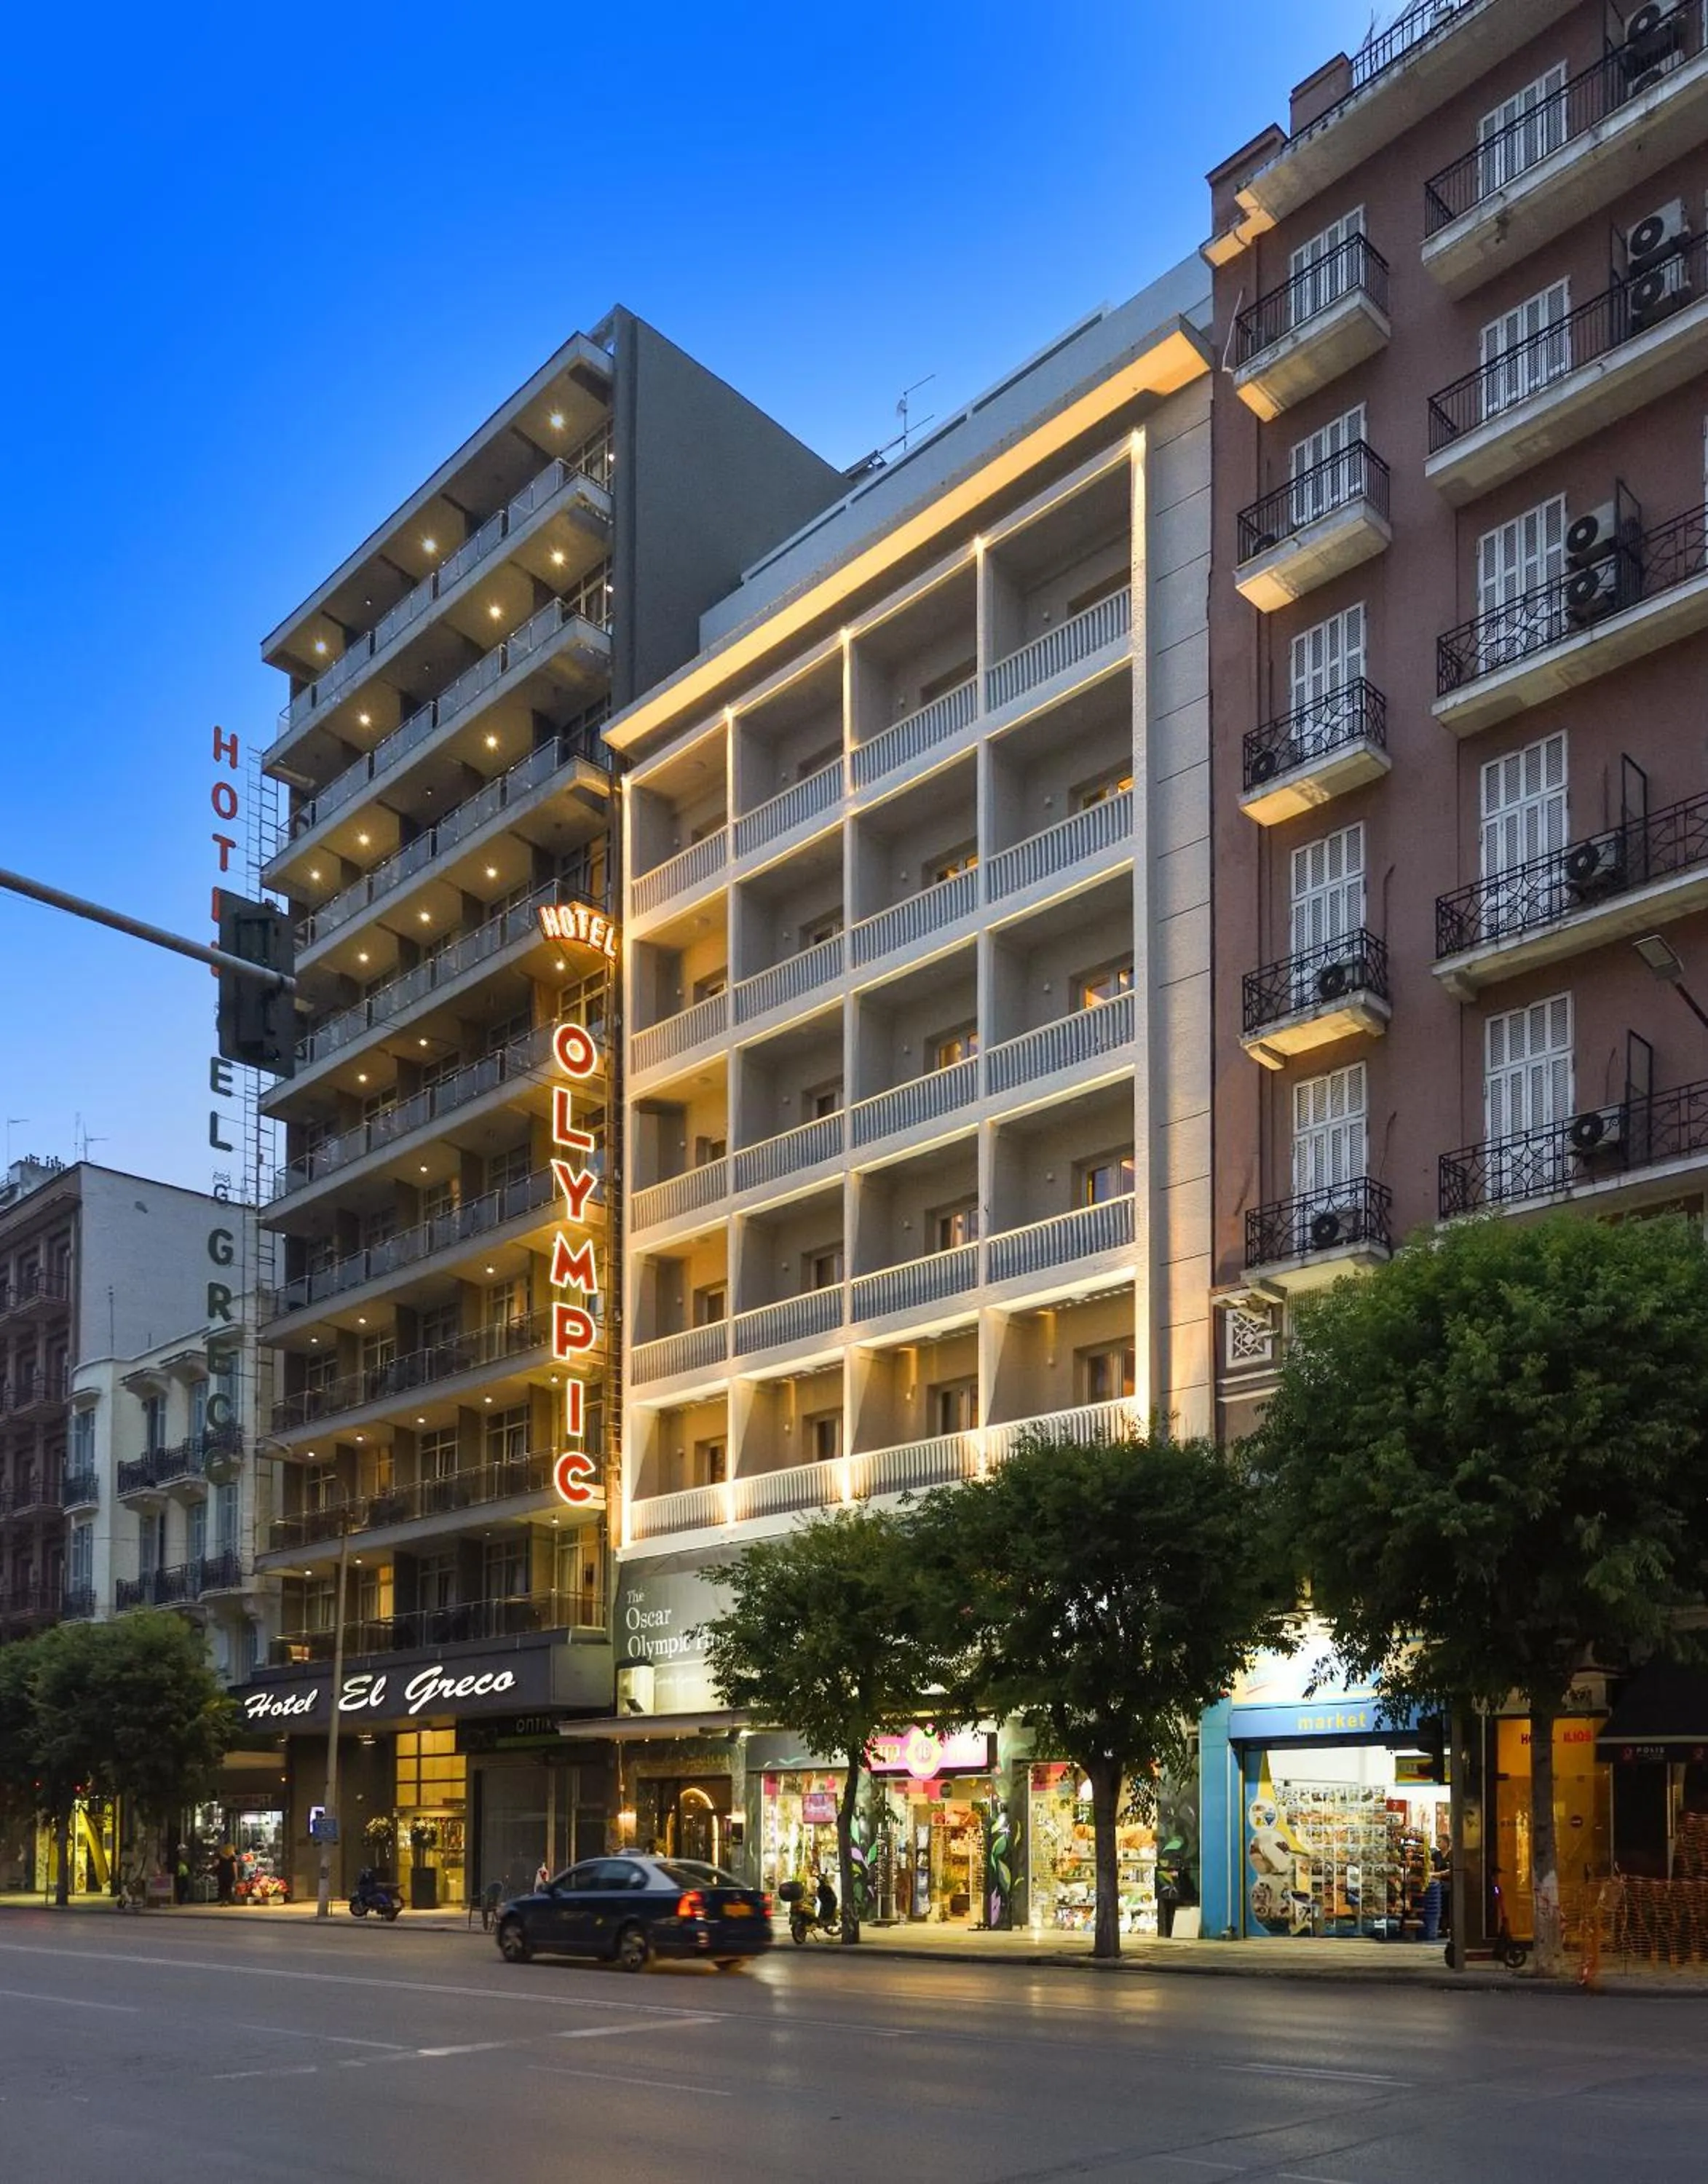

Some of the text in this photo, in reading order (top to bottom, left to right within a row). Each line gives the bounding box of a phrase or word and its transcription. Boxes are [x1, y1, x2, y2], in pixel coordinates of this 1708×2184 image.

[211, 725, 238, 978] HOT
[538, 905, 617, 960] HOTEL
[209, 1056, 234, 1152] EL
[550, 1022, 598, 1504] OLYMPIC
[205, 1227, 234, 1486] GRECO
[626, 1607, 672, 1630] Oscar
[627, 1589, 645, 1604] The
[627, 1631, 690, 1661] Olympic
[244, 1665, 516, 1719] Hotel El Greco
[1297, 1712, 1366, 1731] market
[1562, 1730, 1592, 1744] ILIOS
